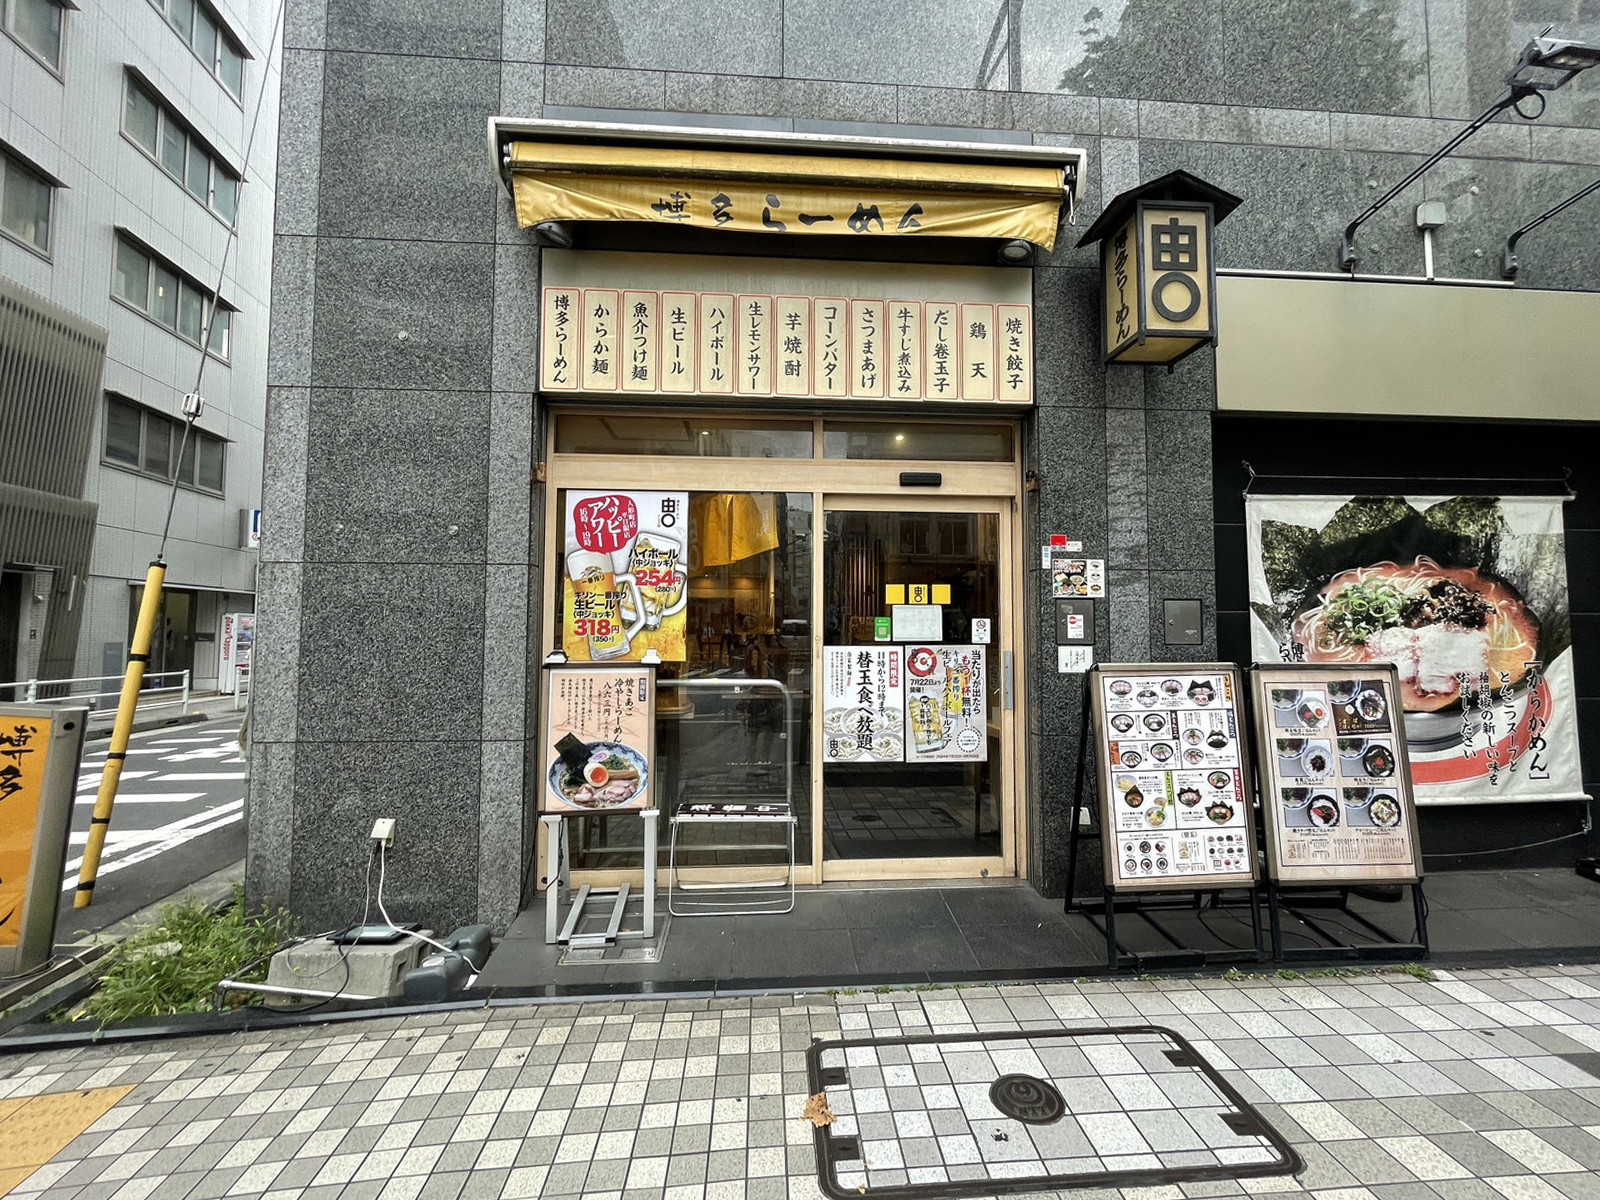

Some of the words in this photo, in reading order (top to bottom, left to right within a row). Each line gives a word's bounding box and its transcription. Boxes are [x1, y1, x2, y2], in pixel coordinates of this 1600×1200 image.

[651, 191, 923, 233] 博多らーめん
[554, 294, 570, 384] 博多らーめん
[592, 304, 610, 375] からか麺
[632, 302, 649, 381] 魚介つけ麺
[671, 307, 687, 375] 生ビール
[710, 308, 725, 381] ハイボール
[748, 301, 763, 390] 生レモンサワー
[784, 313, 802, 377] 芋焼酎
[824, 306, 839, 390] コーンバター
[861, 308, 877, 389] さつまあげ
[897, 308, 914, 393] 牛すじ煮込み
[933, 309, 950, 393] だし巻玉子
[970, 322, 988, 379] 鶏天
[1006, 317, 1024, 390] 焼き餃子
[587, 502, 605, 548] アワー
[601, 497, 622, 548] ハッピー
[629, 548, 679, 560] ハイボール
[574, 600, 616, 610] 生ビール
[575, 591, 627, 600] キリン一番搾り
[635, 569, 681, 586] 254円
[574, 619, 620, 636] 318円
[613, 678, 625, 743] 冷やしらーめん
[625, 678, 635, 717] 焼きあご
[856, 651, 875, 751] 替玉食べ放題
[972, 650, 981, 715] 当たりが出たら
[1460, 672, 1476, 759] お試しください
[1479, 672, 1499, 786] 柚胡椒の新しい味を
[1500, 672, 1518, 773] とんこつスープと
